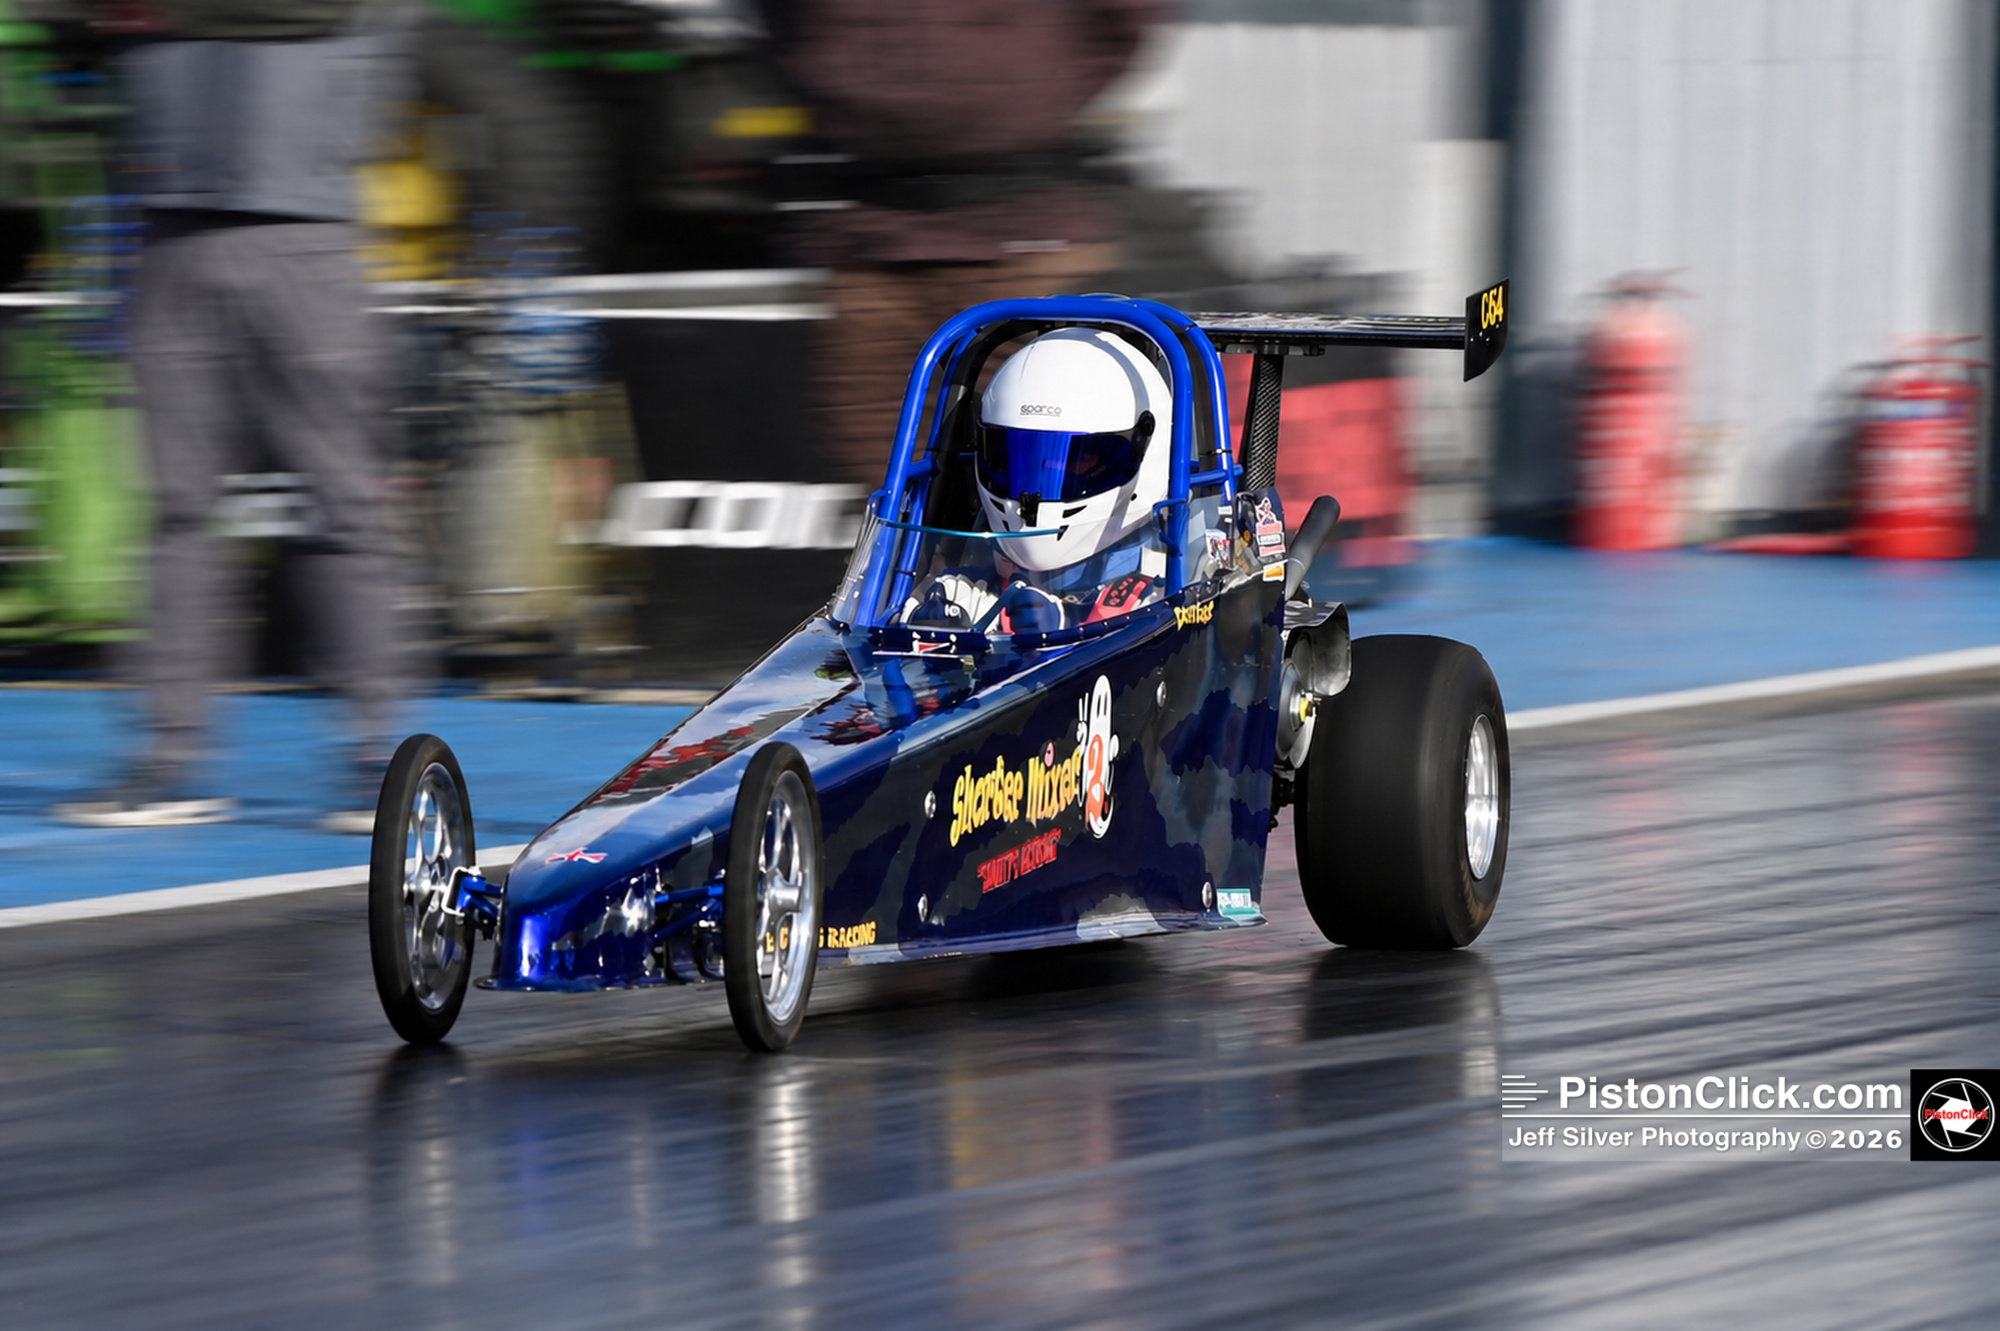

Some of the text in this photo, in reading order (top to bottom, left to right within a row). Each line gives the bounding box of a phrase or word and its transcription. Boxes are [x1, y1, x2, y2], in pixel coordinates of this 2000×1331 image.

[1481, 285, 1504, 330] C64
[1020, 404, 1062, 416] sparco
[827, 920, 877, 949] RACING
